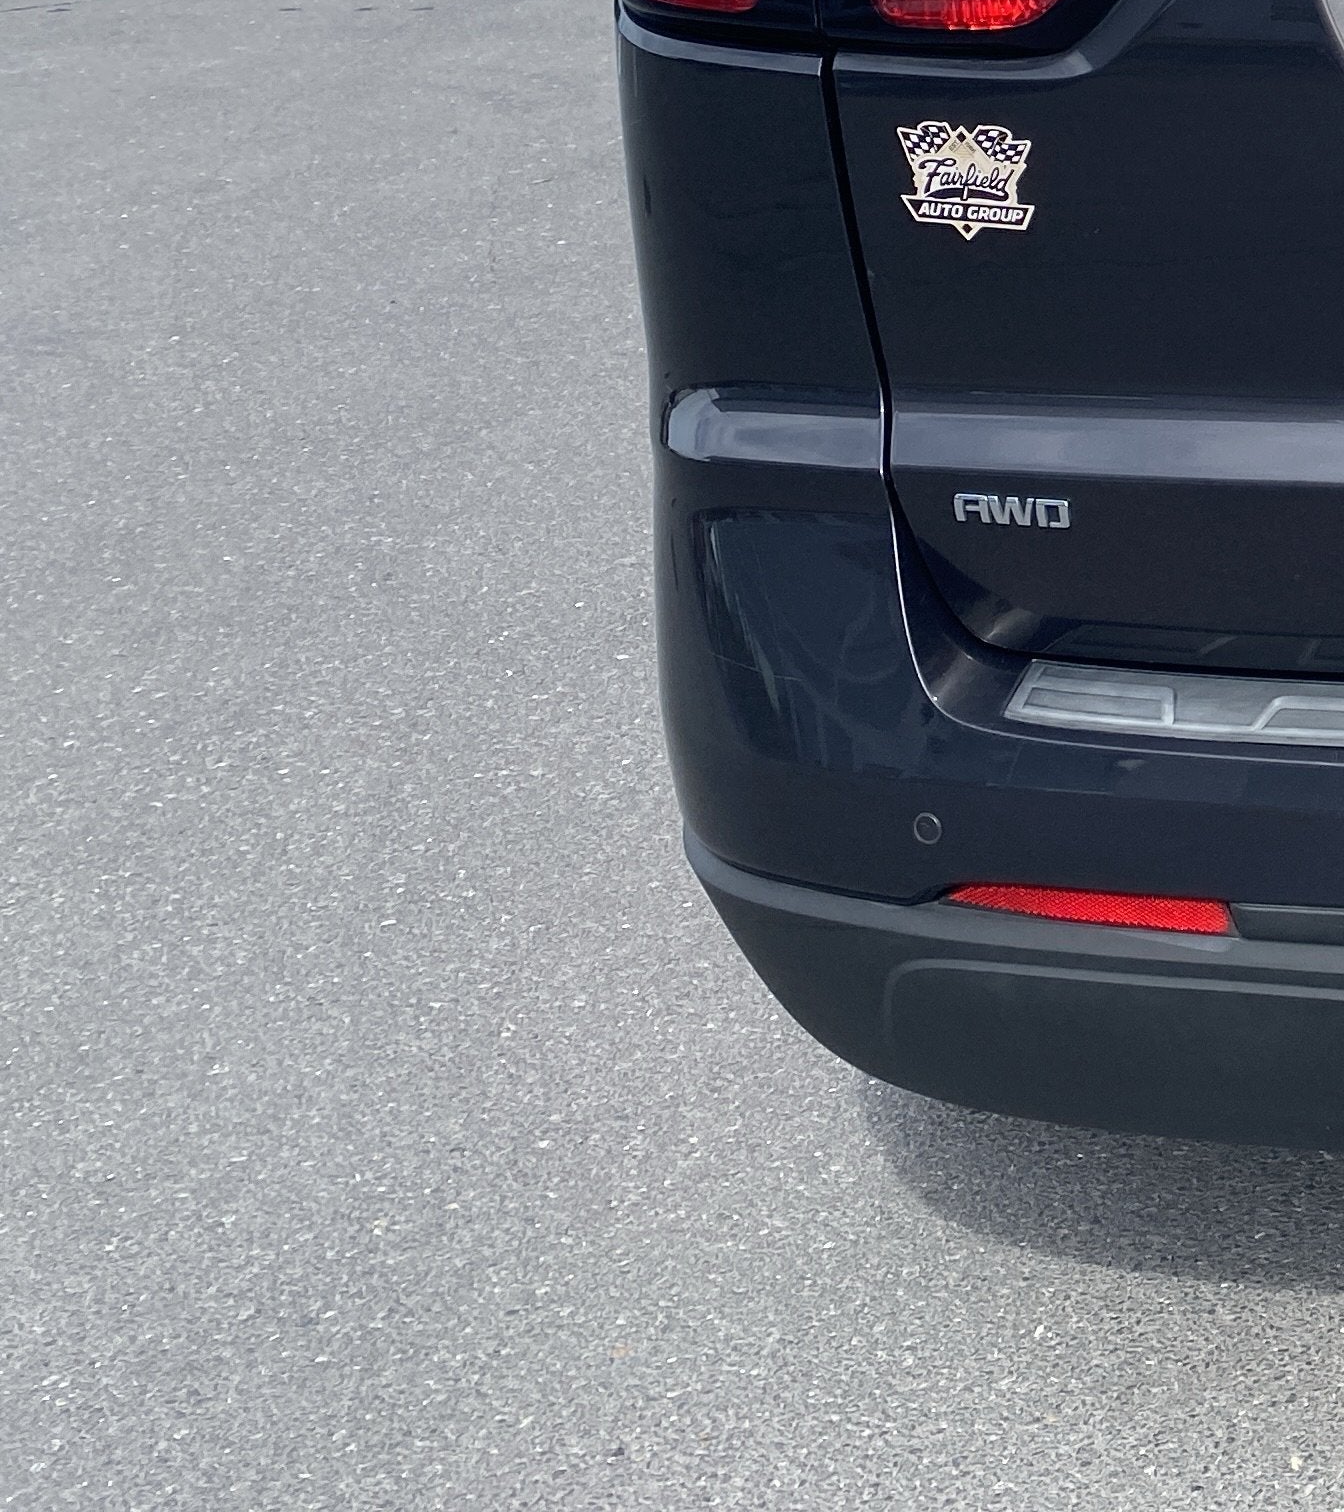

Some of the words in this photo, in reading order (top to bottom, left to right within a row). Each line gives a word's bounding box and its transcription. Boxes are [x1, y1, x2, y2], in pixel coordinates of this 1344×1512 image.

[918, 157, 1015, 196] Fairfield
[918, 202, 964, 219] AUTO
[966, 206, 1024, 224] GROUP
[953, 493, 1071, 529] AWD
